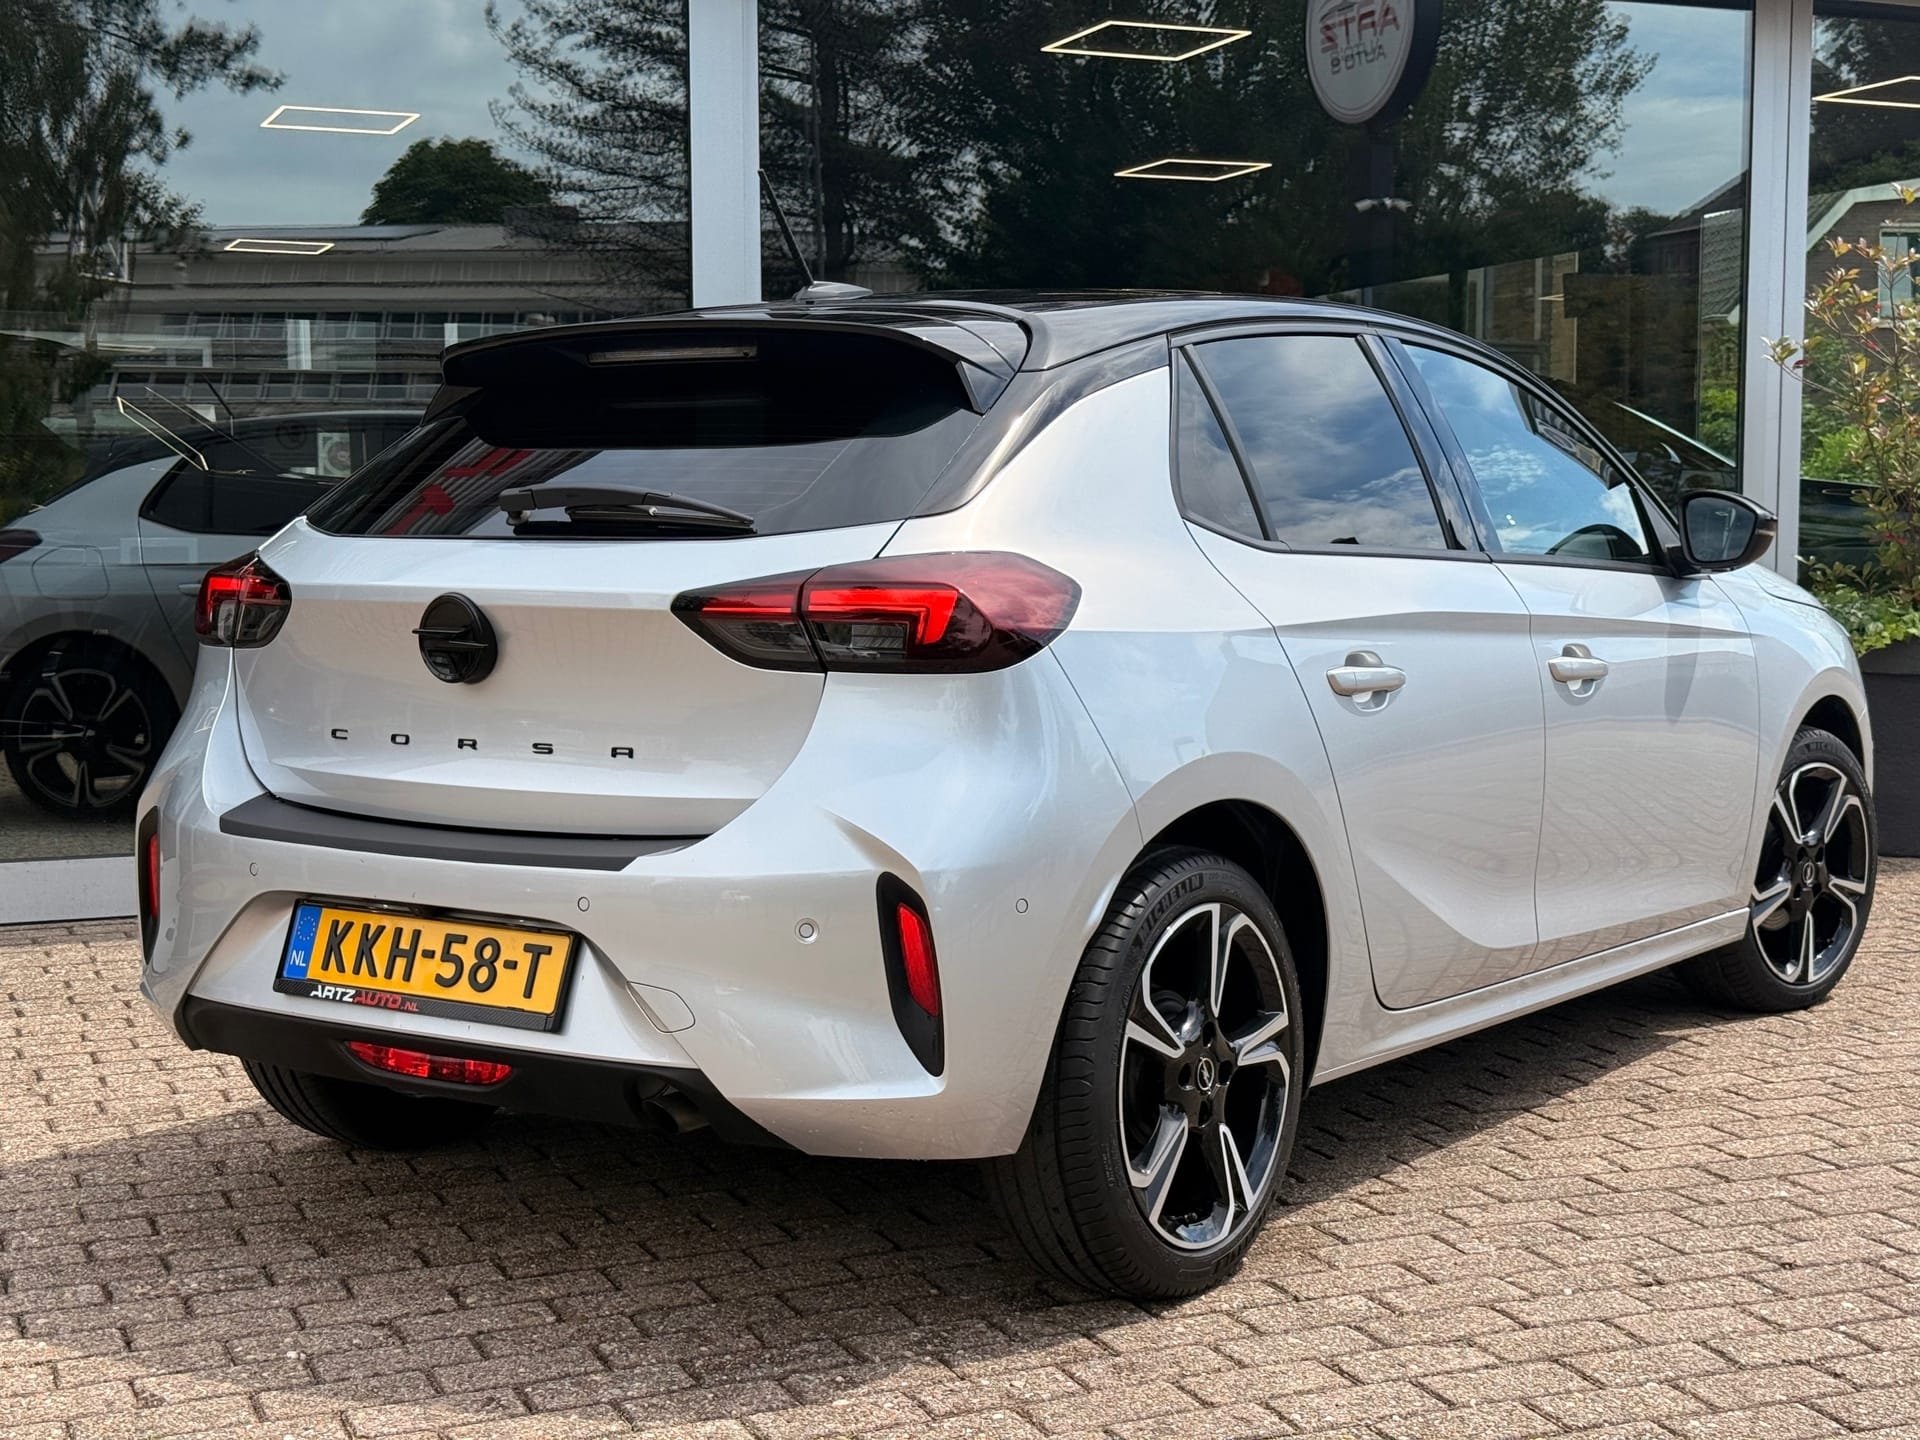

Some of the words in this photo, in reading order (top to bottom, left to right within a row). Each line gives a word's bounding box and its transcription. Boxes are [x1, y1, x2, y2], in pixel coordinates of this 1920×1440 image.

[331, 728, 633, 759] CORSA
[1139, 874, 1203, 943] MICHELIN
[290, 949, 306, 967] NL
[321, 919, 552, 998] KKH-58-T
